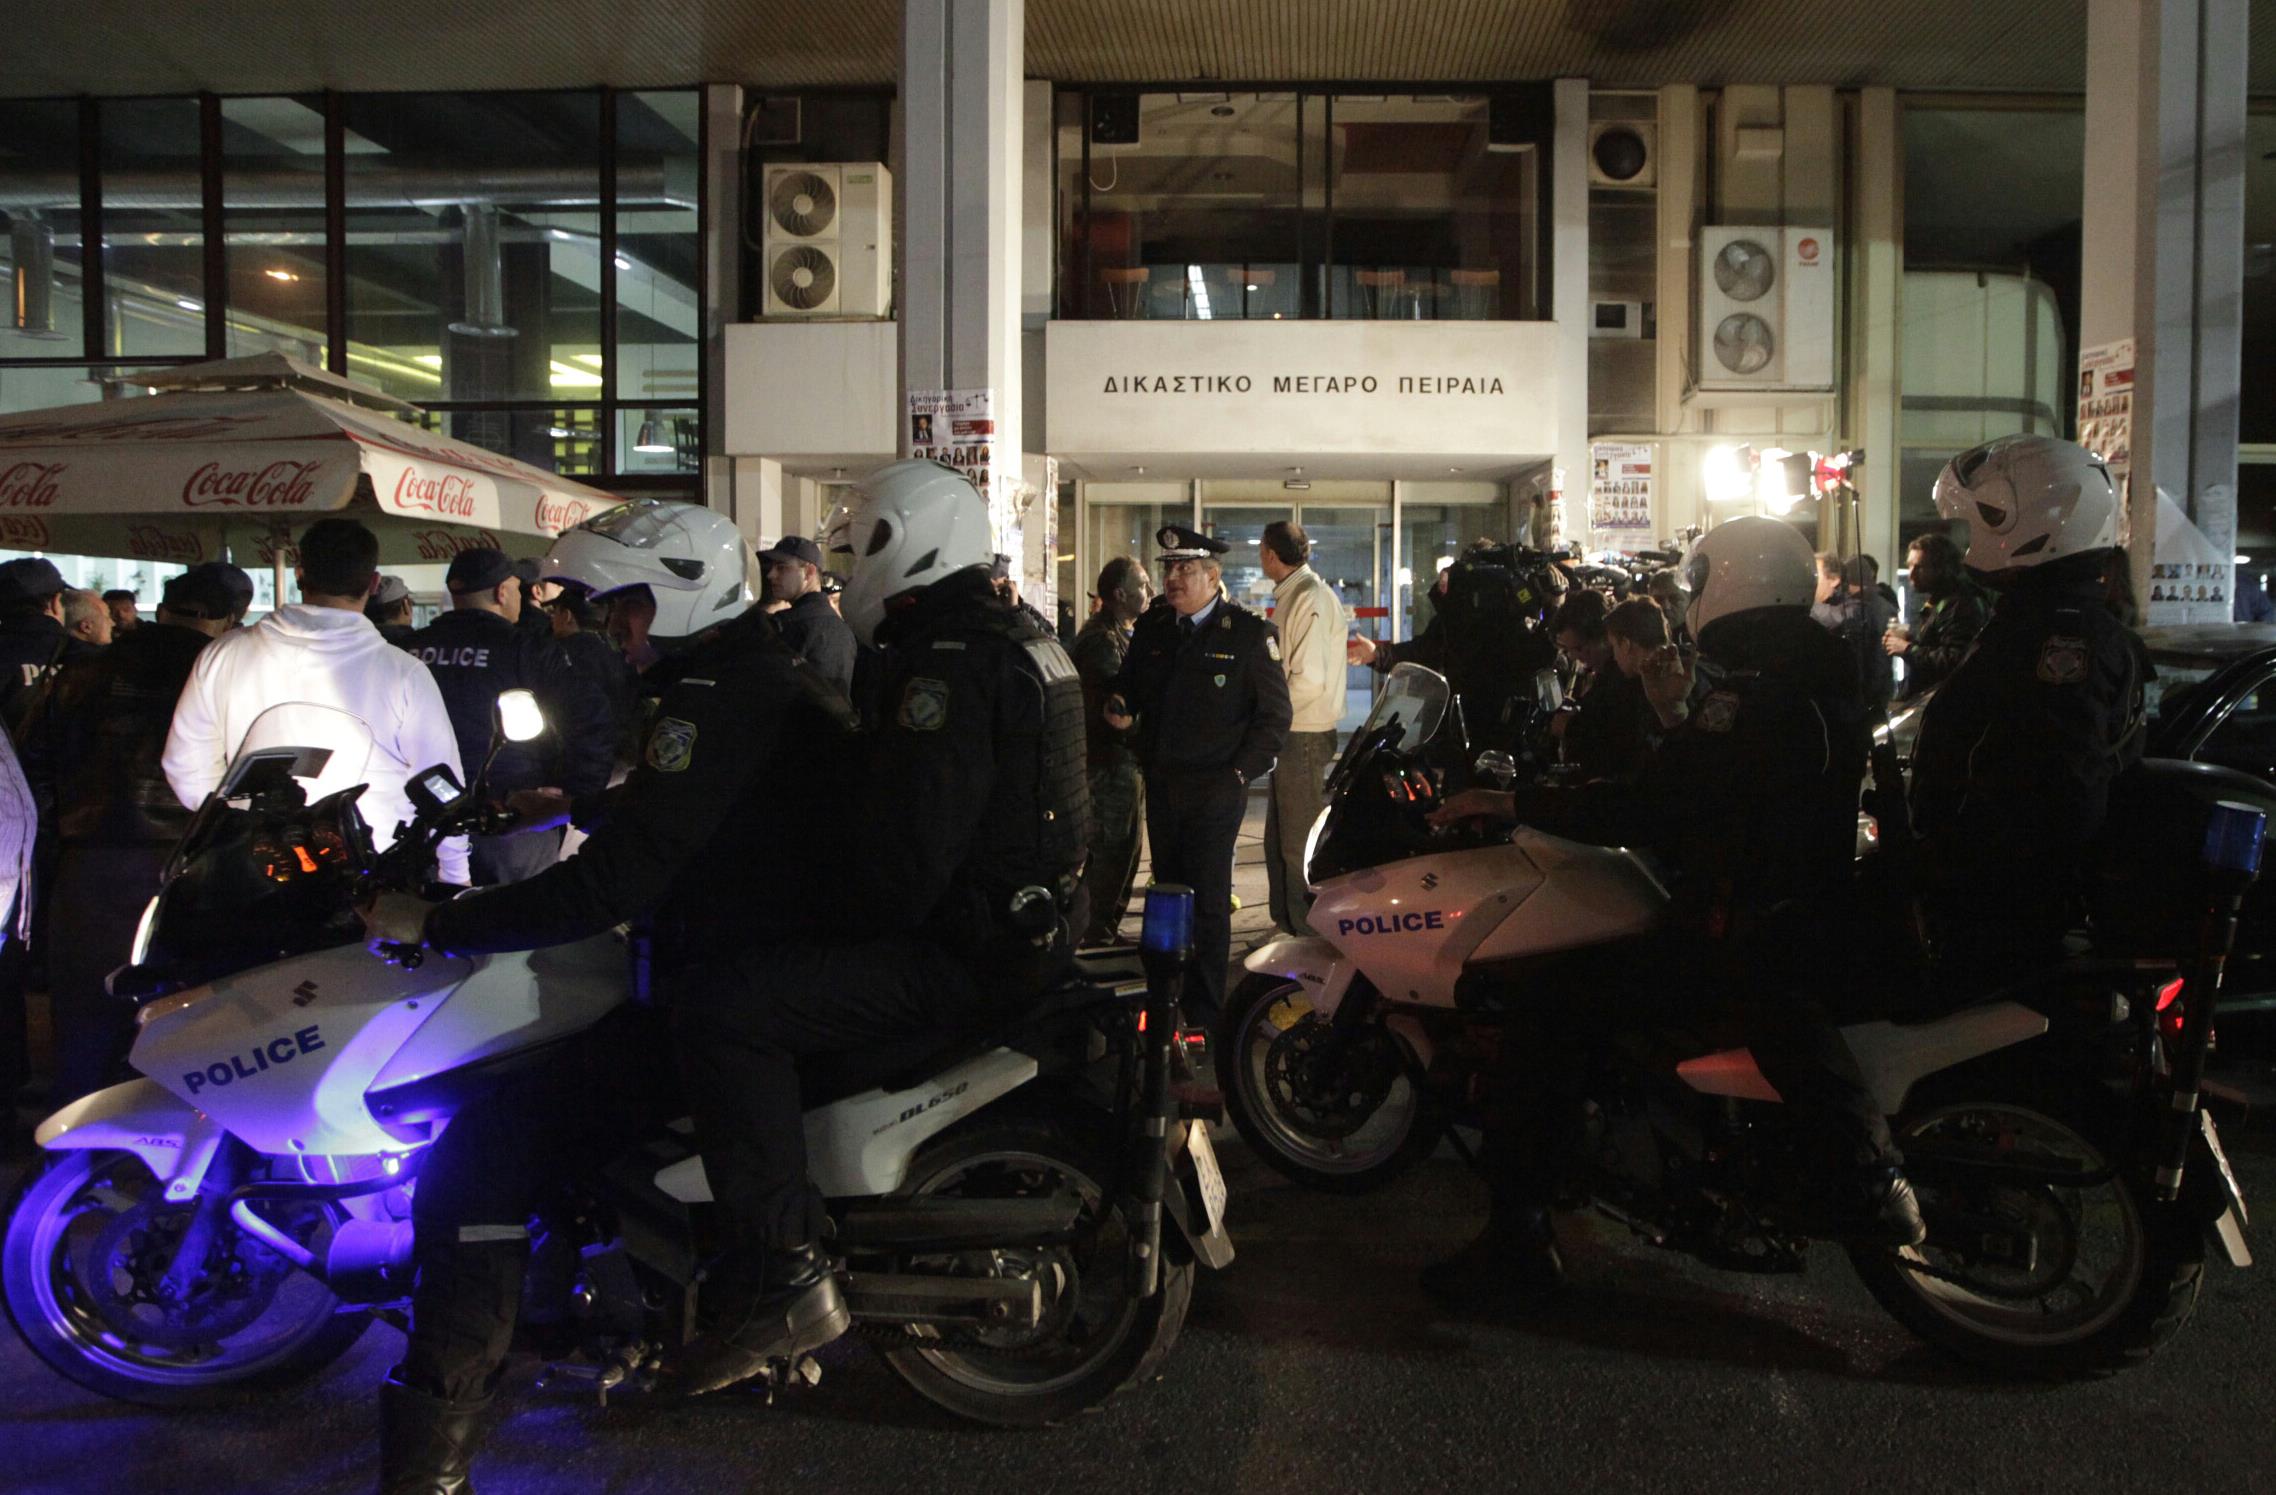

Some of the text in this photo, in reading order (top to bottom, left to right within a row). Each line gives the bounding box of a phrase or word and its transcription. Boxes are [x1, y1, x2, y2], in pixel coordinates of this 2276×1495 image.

[1103, 375, 1505, 395] ΔΙΚΑΣΤΙΚΟ ΜΕΓΑΡΟ ΠΕΙΡΑΙΑ
[183, 460, 322, 506] Coca-Cola
[394, 466, 476, 517] Coca-Cola
[535, 494, 592, 532] Coca-Col
[1338, 911, 1445, 936] POLICE
[183, 1024, 326, 1095] POLICE
